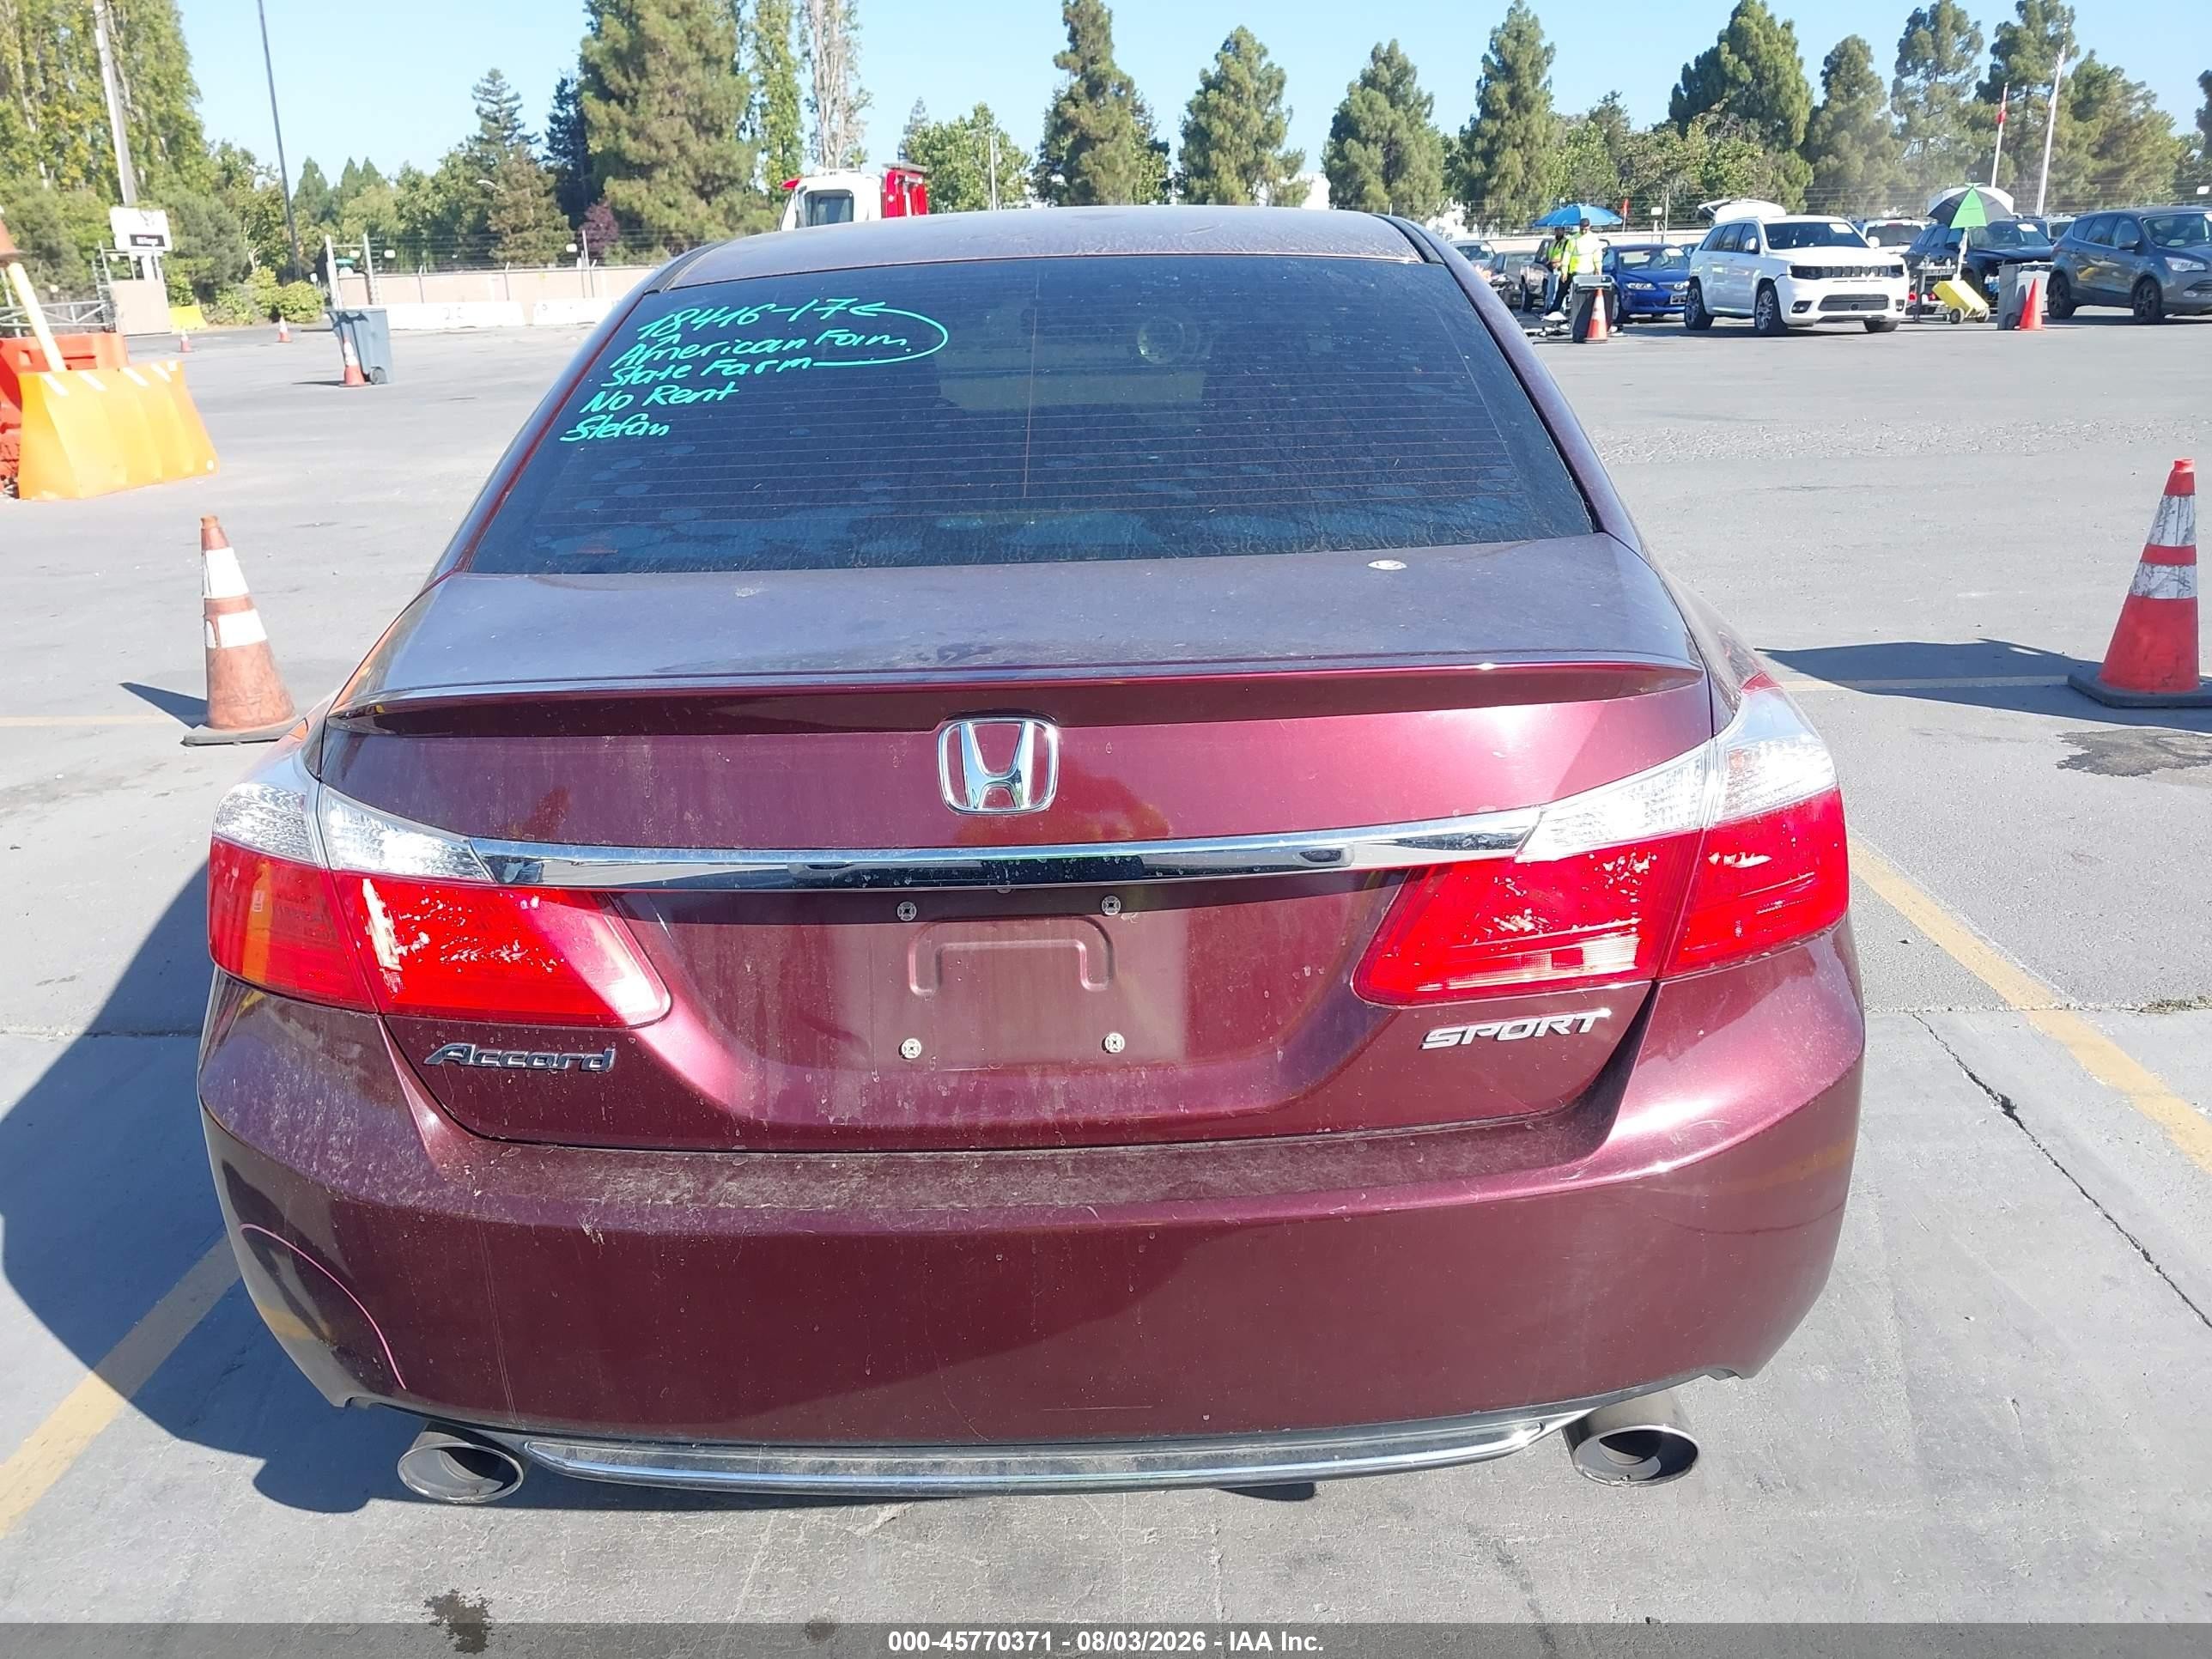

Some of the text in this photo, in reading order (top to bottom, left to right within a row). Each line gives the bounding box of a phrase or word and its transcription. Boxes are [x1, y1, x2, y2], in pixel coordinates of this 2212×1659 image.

[609, 332, 807, 368] American
[600, 357, 812, 387] State Farm
[579, 380, 740, 414] No Rent
[559, 413, 671, 442] Stefan
[1420, 1006, 1613, 1050] SPORT
[423, 1042, 617, 1073] Accord
